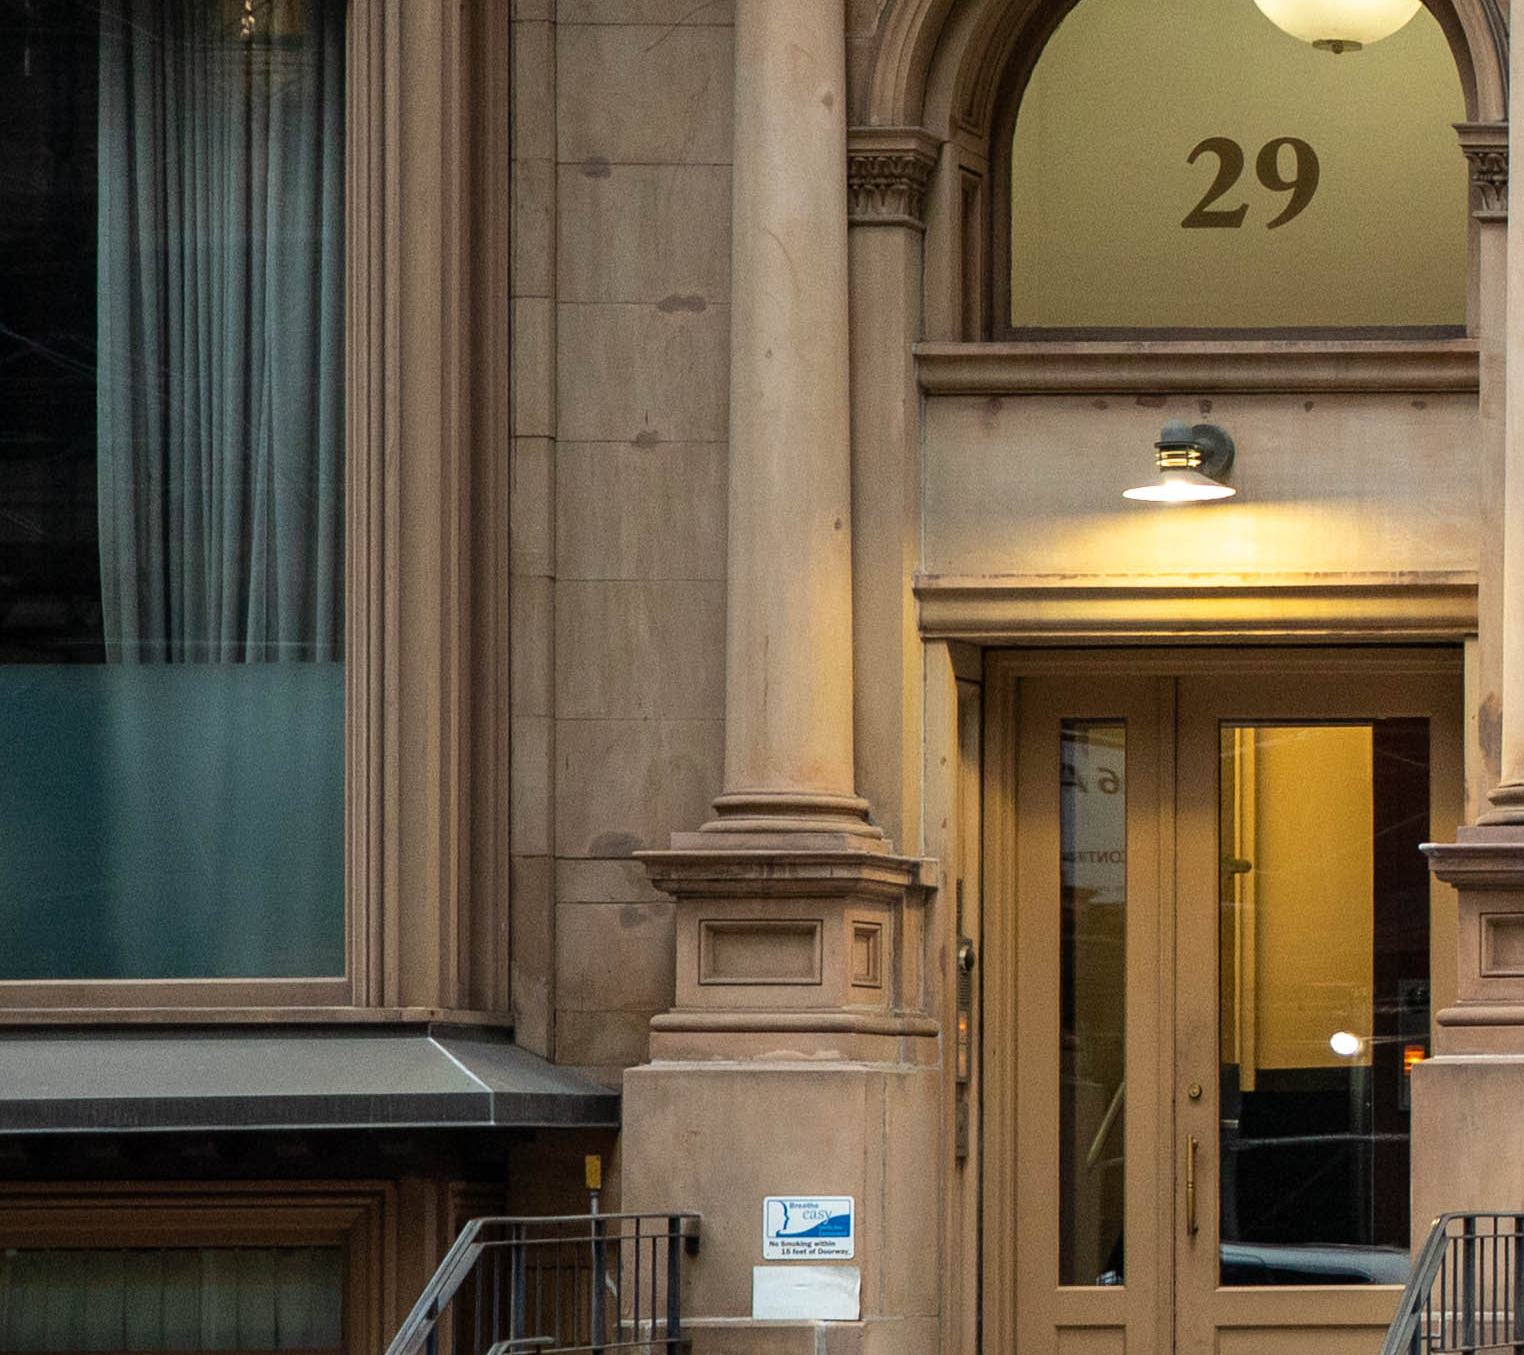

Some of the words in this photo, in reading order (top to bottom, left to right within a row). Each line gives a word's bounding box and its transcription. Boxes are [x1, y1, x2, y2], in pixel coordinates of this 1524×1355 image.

[1181, 137, 1320, 230] 29
[802, 1210, 832, 1225] easy
[781, 1240, 812, 1248] Smoking
